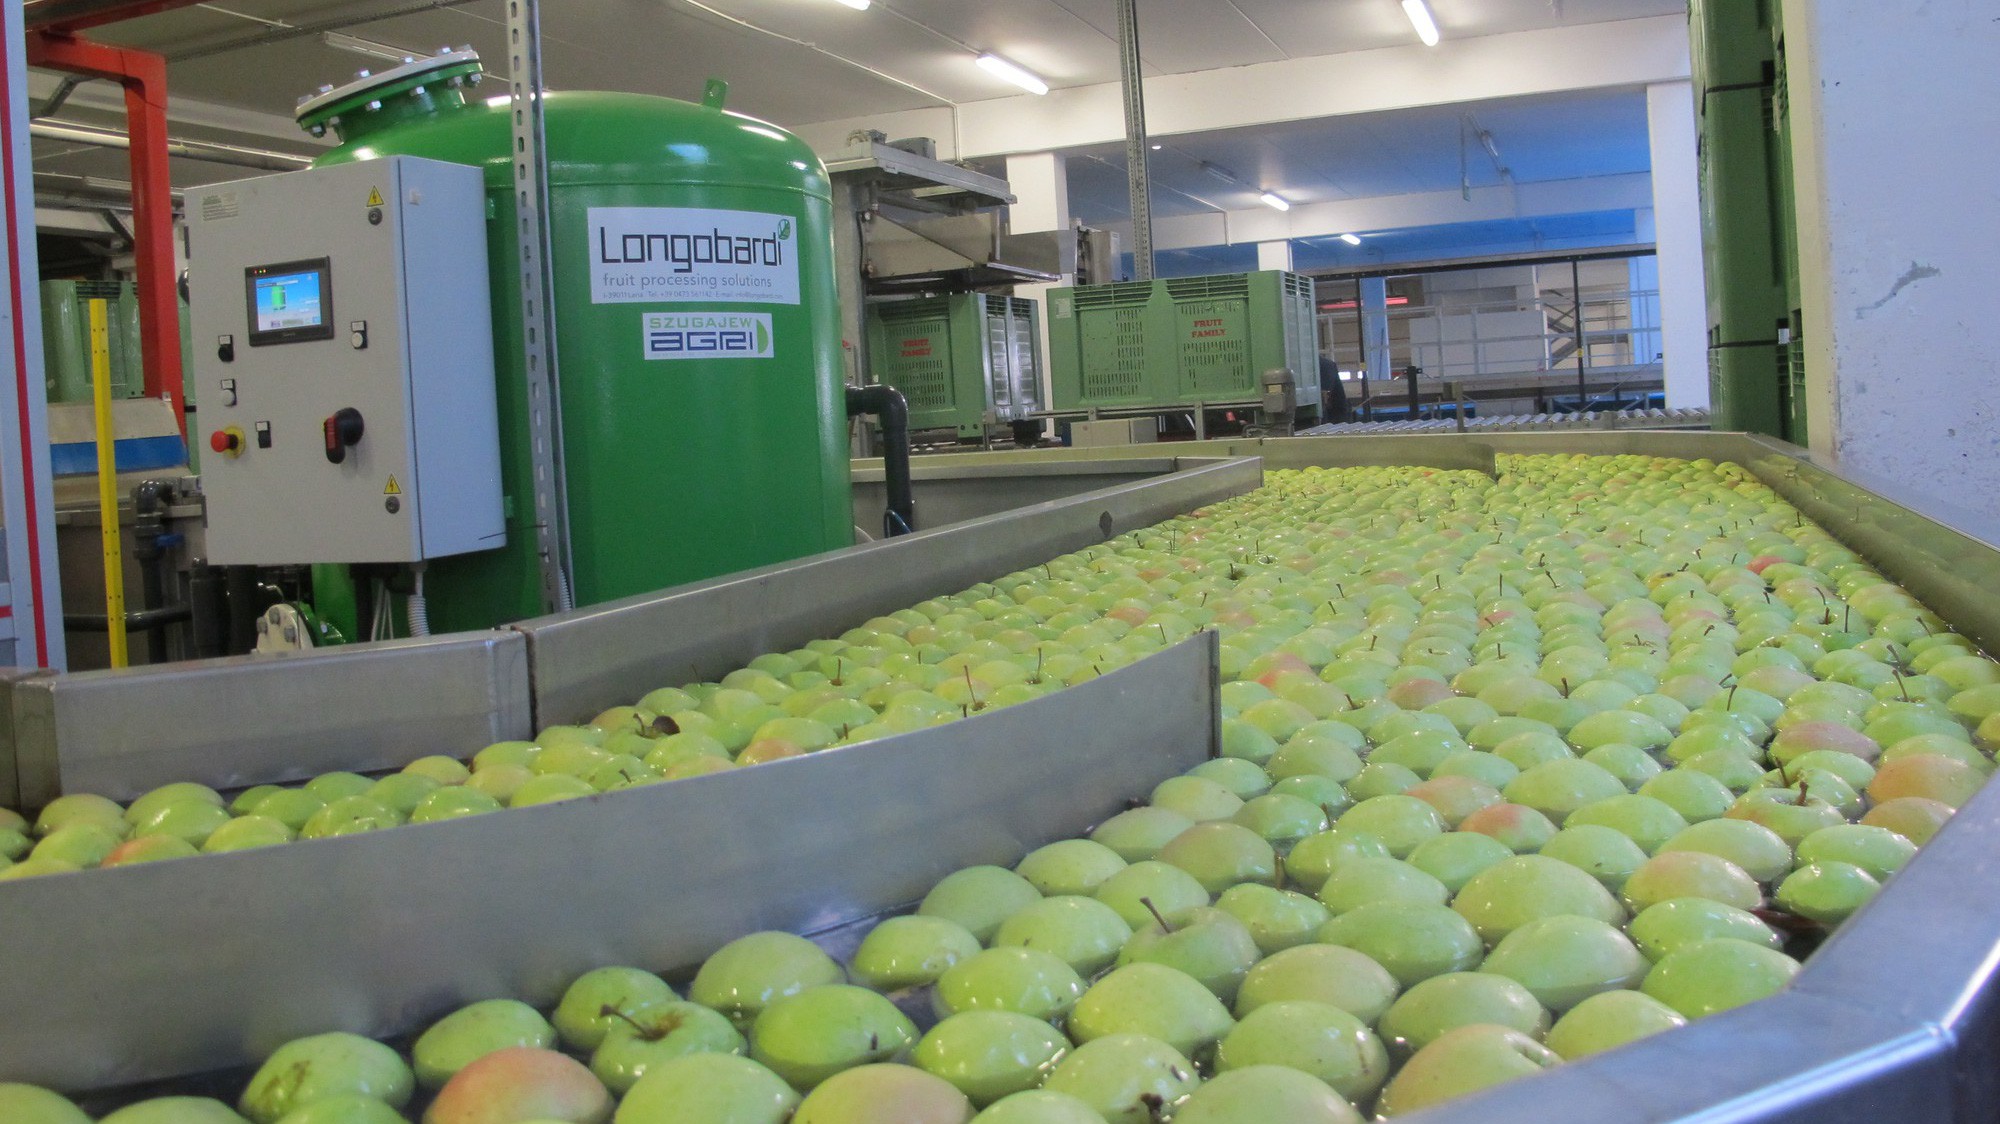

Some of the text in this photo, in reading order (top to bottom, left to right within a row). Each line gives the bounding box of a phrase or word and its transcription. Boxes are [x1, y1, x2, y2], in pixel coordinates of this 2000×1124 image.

[600, 219, 791, 273] Longobardi
[603, 272, 772, 290] fruit processing solutions
[649, 317, 753, 329] SZUGAJEW
[1193, 319, 1223, 327] FRUIT
[1191, 328, 1226, 338] FAMILY
